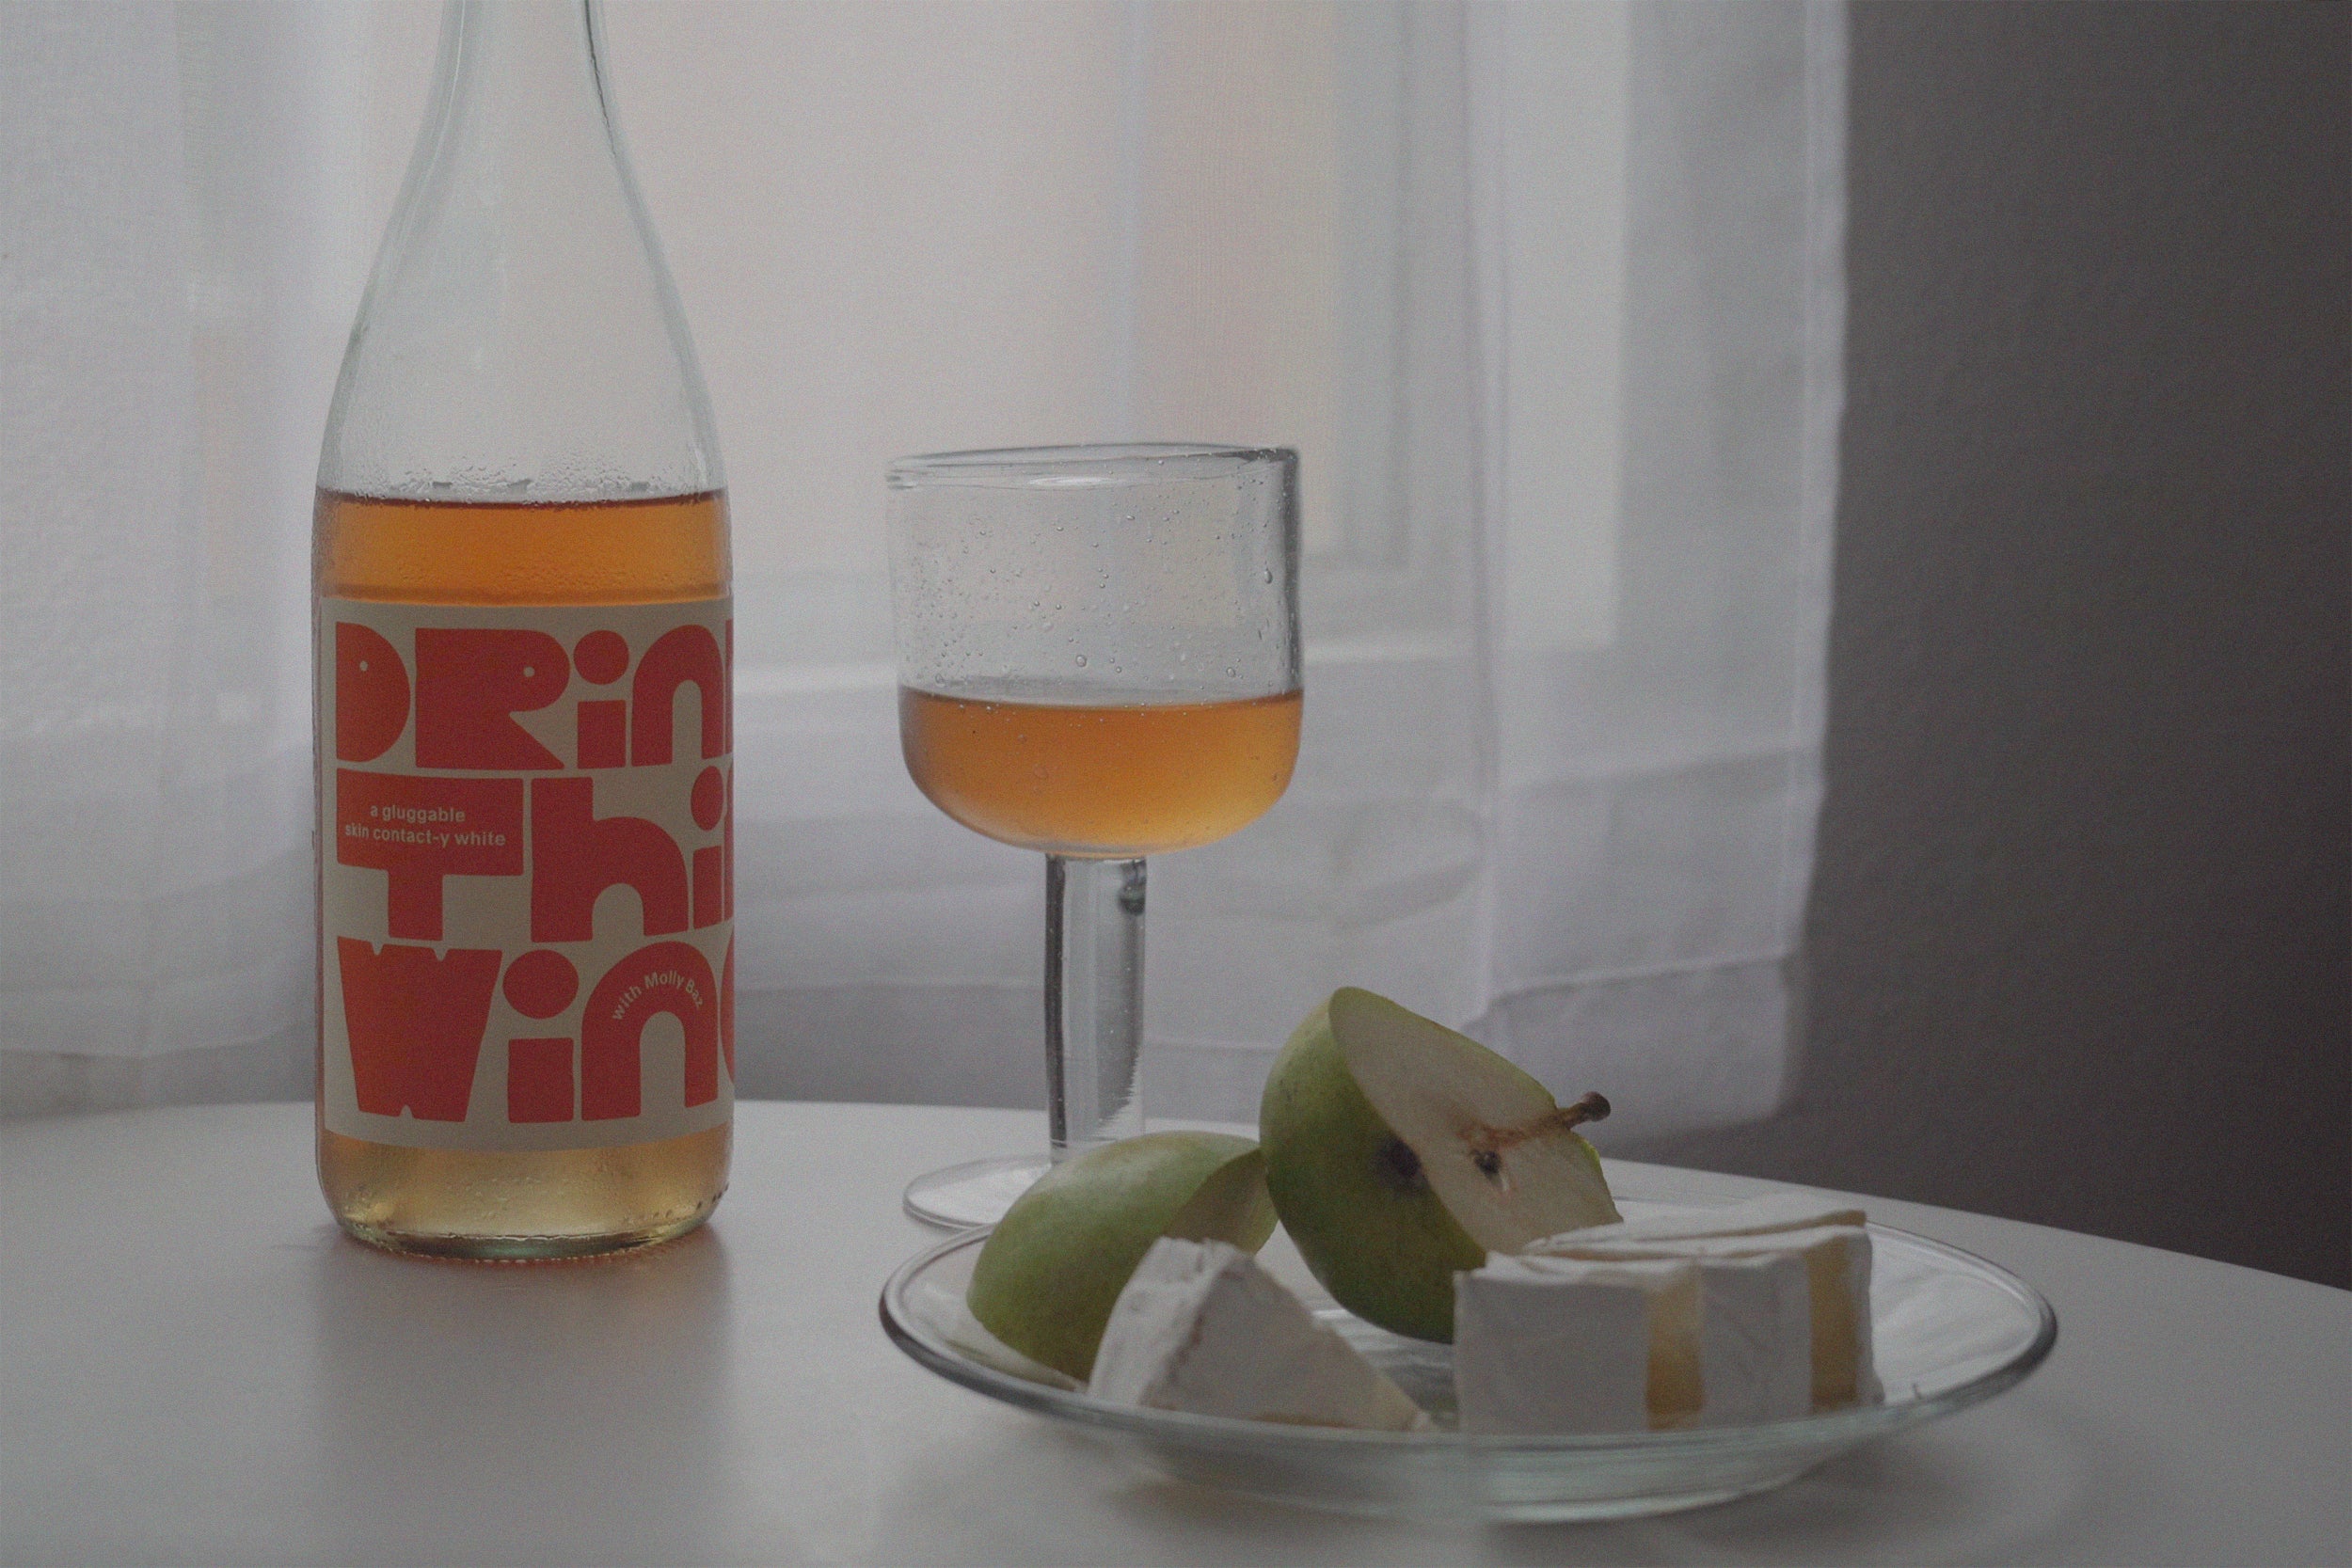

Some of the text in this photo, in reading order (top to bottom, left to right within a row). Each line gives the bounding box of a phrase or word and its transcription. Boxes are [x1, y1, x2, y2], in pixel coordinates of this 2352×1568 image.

[336, 620, 733, 770] DRin
[336, 766, 733, 942] Thi
[345, 822, 506, 847] skin contact-y white
[370, 805, 466, 824] a gluggable
[337, 935, 733, 1123] Win
[612, 970, 704, 1020] with Molly Baz
